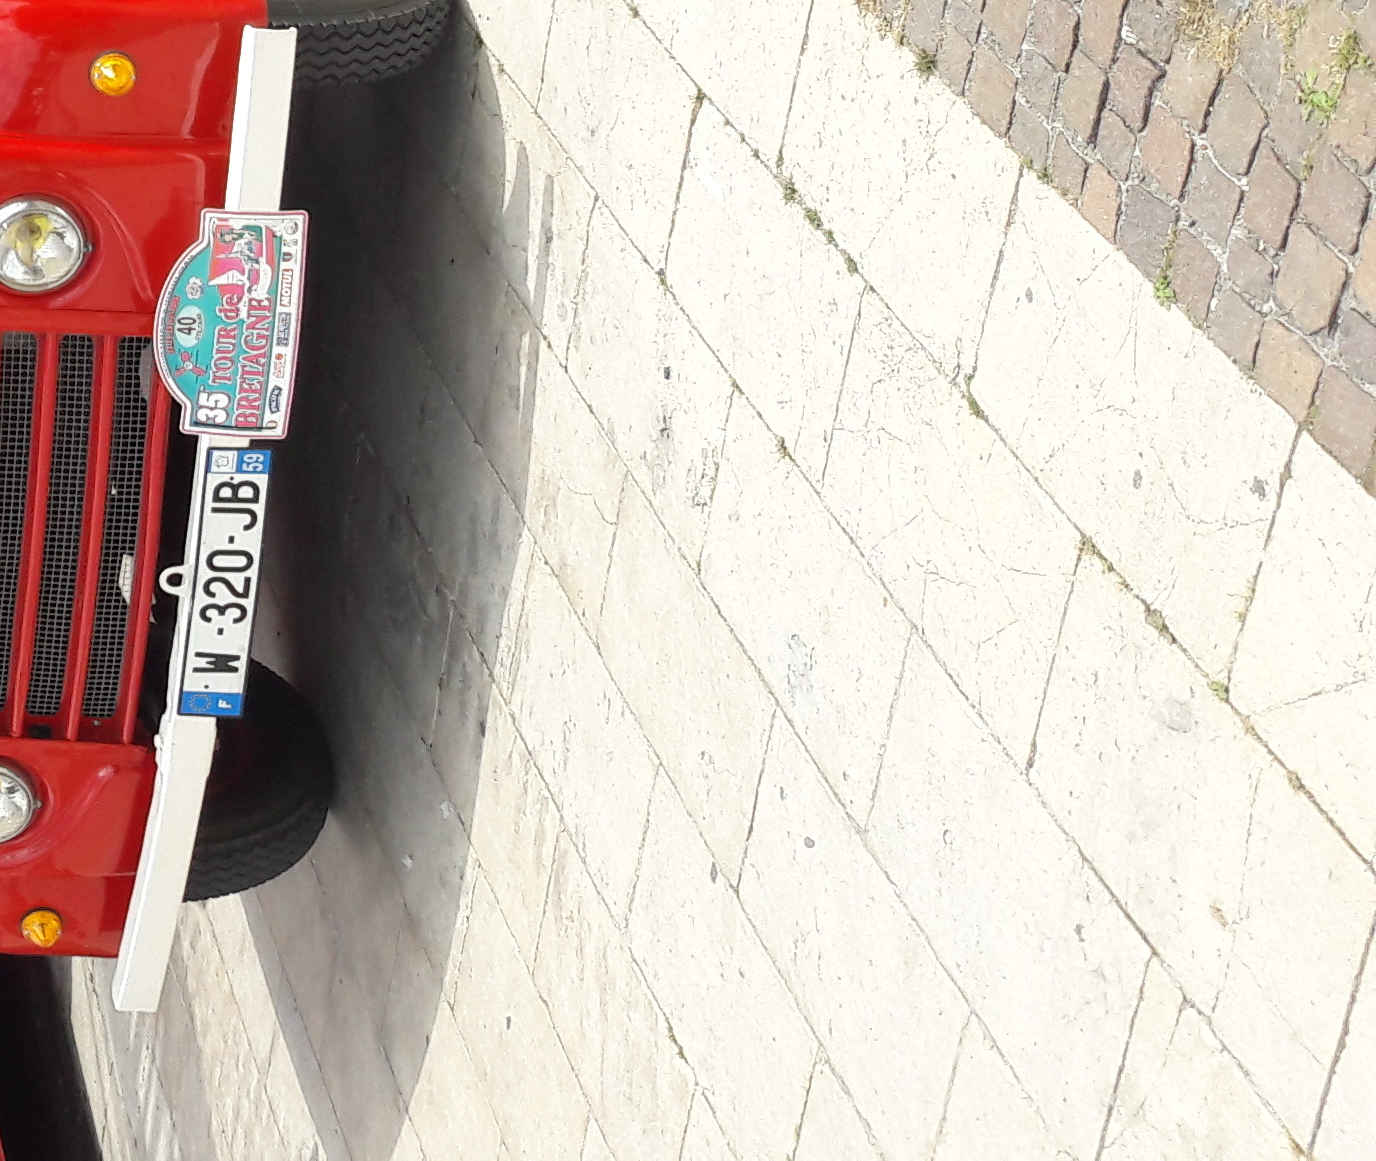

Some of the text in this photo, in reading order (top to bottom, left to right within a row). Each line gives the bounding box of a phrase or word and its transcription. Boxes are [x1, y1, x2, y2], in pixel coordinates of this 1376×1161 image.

[280, 268, 293, 308] MOTUL
[176, 316, 198, 336] 40
[210, 293, 243, 385] TOUR de
[234, 295, 274, 427] BRETAGNE
[241, 452, 265, 472] 59
[217, 699, 233, 710] F
